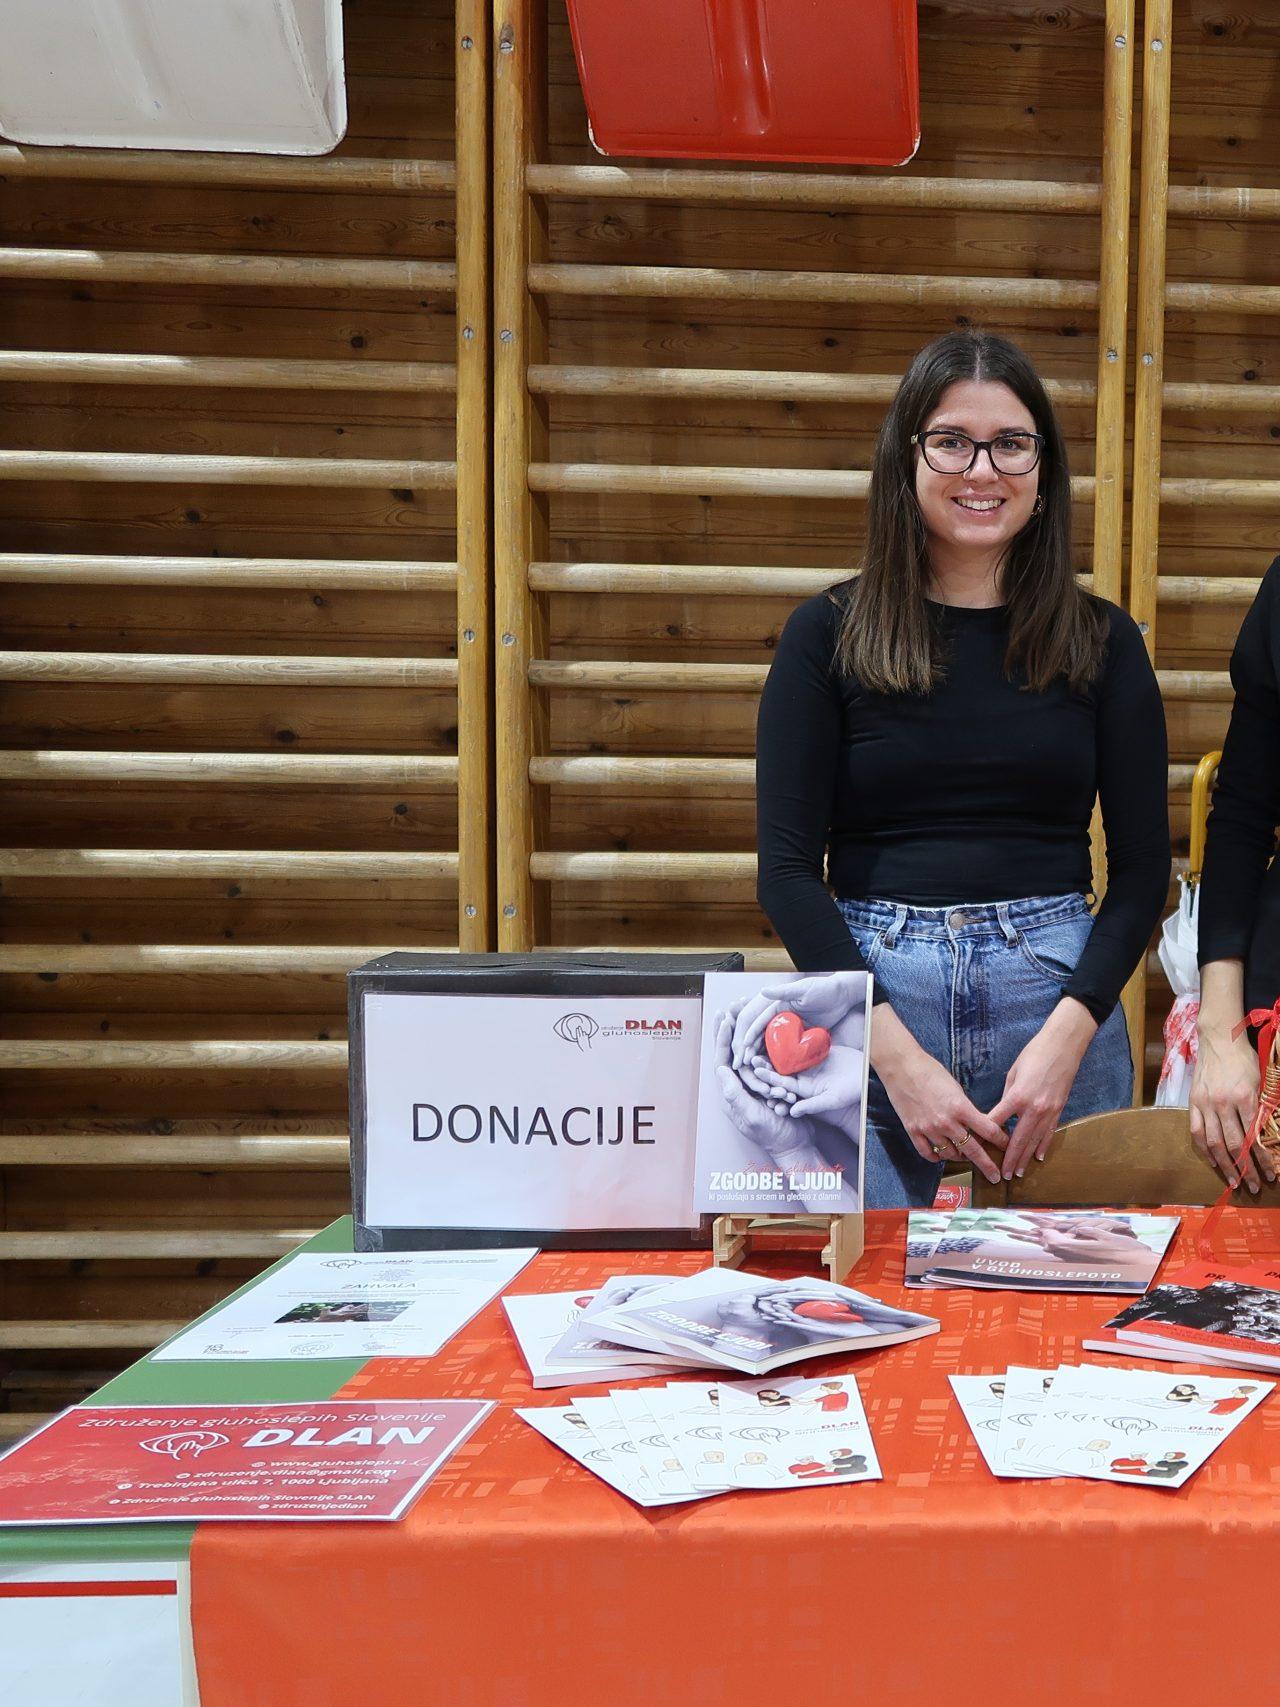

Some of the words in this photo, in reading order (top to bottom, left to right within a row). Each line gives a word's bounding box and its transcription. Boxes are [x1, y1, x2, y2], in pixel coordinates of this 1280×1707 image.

[625, 1019, 683, 1030] DLAN
[412, 1103, 656, 1146] DONACIJE
[709, 1171, 783, 1191] ZGODBE
[789, 1171, 842, 1191] LJUDI
[975, 1257, 1021, 1268] UVOD
[971, 1263, 981, 1271] V
[987, 1265, 1122, 1280] GLUHOSLEPOTO
[650, 1310, 722, 1335] ZGODBE
[716, 1332, 773, 1350] LJUDI
[78, 1416, 197, 1428] Združenje
[199, 1414, 337, 1428] gluhoslepih
[342, 1413, 446, 1423] Slovenije
[242, 1426, 436, 1447] DLAN
[270, 1459, 407, 1468] www.gluhoslepi.si
[138, 1480, 218, 1489] Trebinjska
[318, 1478, 389, 1487] Ljubljana
[122, 1496, 190, 1505] Združenje
[192, 1495, 271, 1503] gluhoslepih
[272, 1494, 334, 1502] Slovenije
[272, 1502, 367, 1510] zdruzenjedlan
